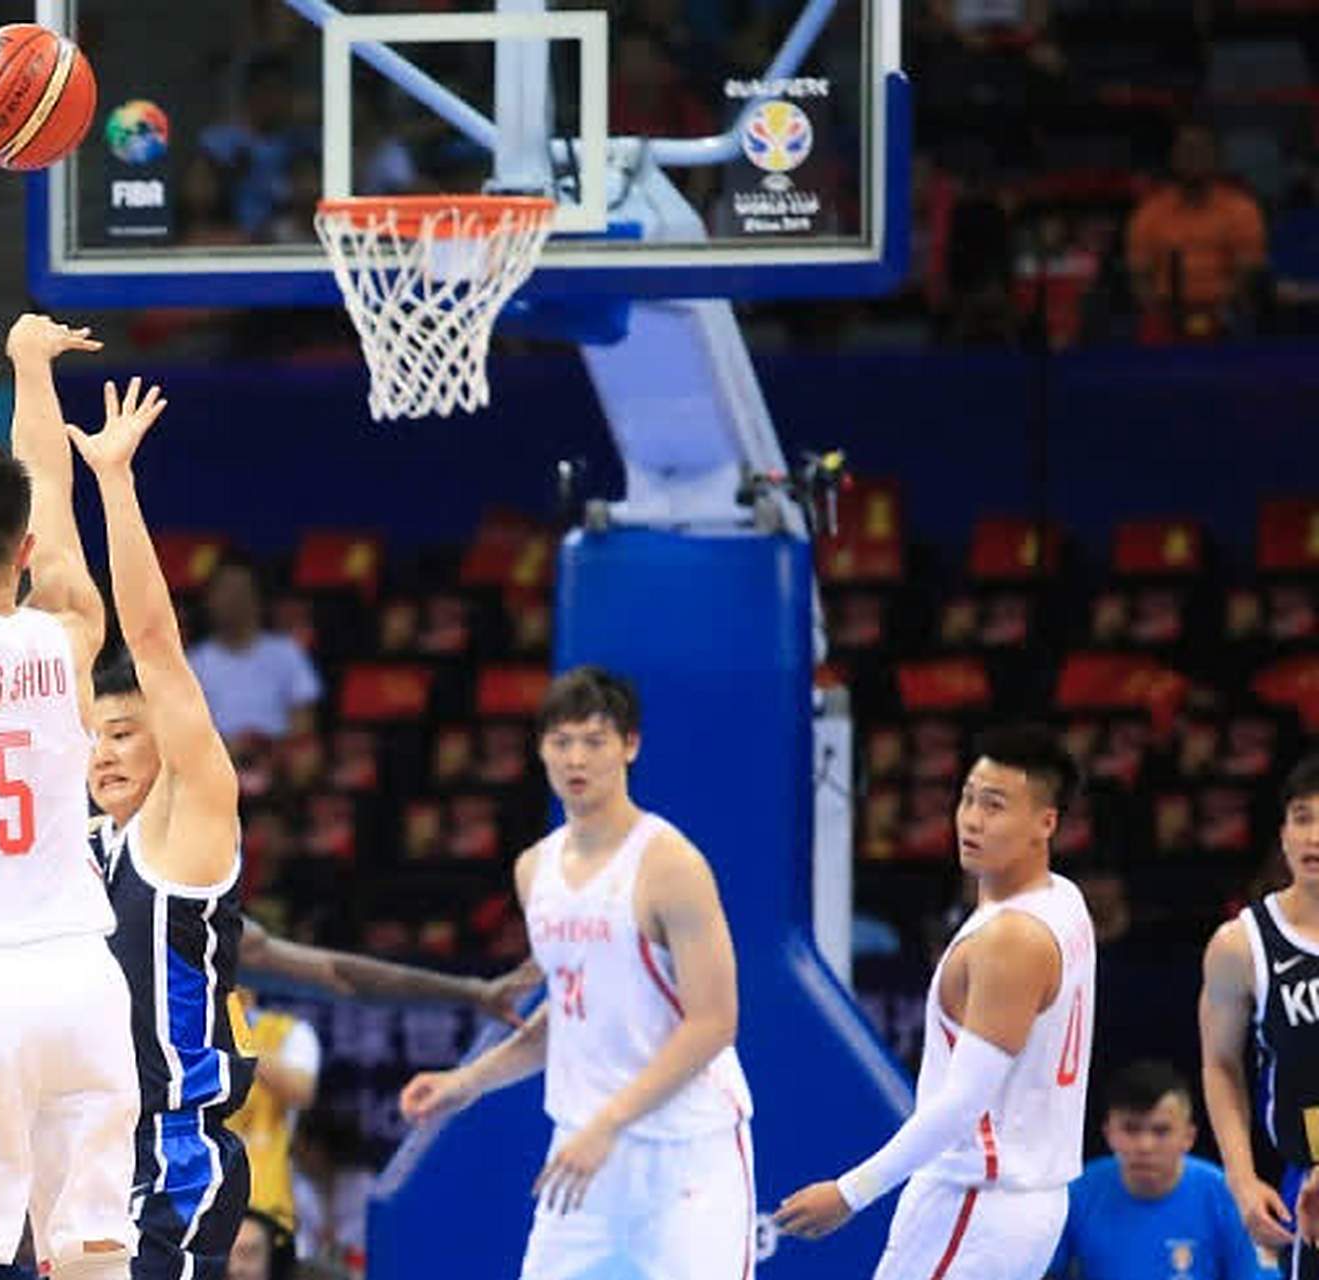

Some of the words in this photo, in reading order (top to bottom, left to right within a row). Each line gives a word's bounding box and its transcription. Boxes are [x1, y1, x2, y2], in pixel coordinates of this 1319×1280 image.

[111, 180, 165, 208] FIBA
[9, 656, 68, 701] SHUO
[532, 915, 612, 944] CHINA
